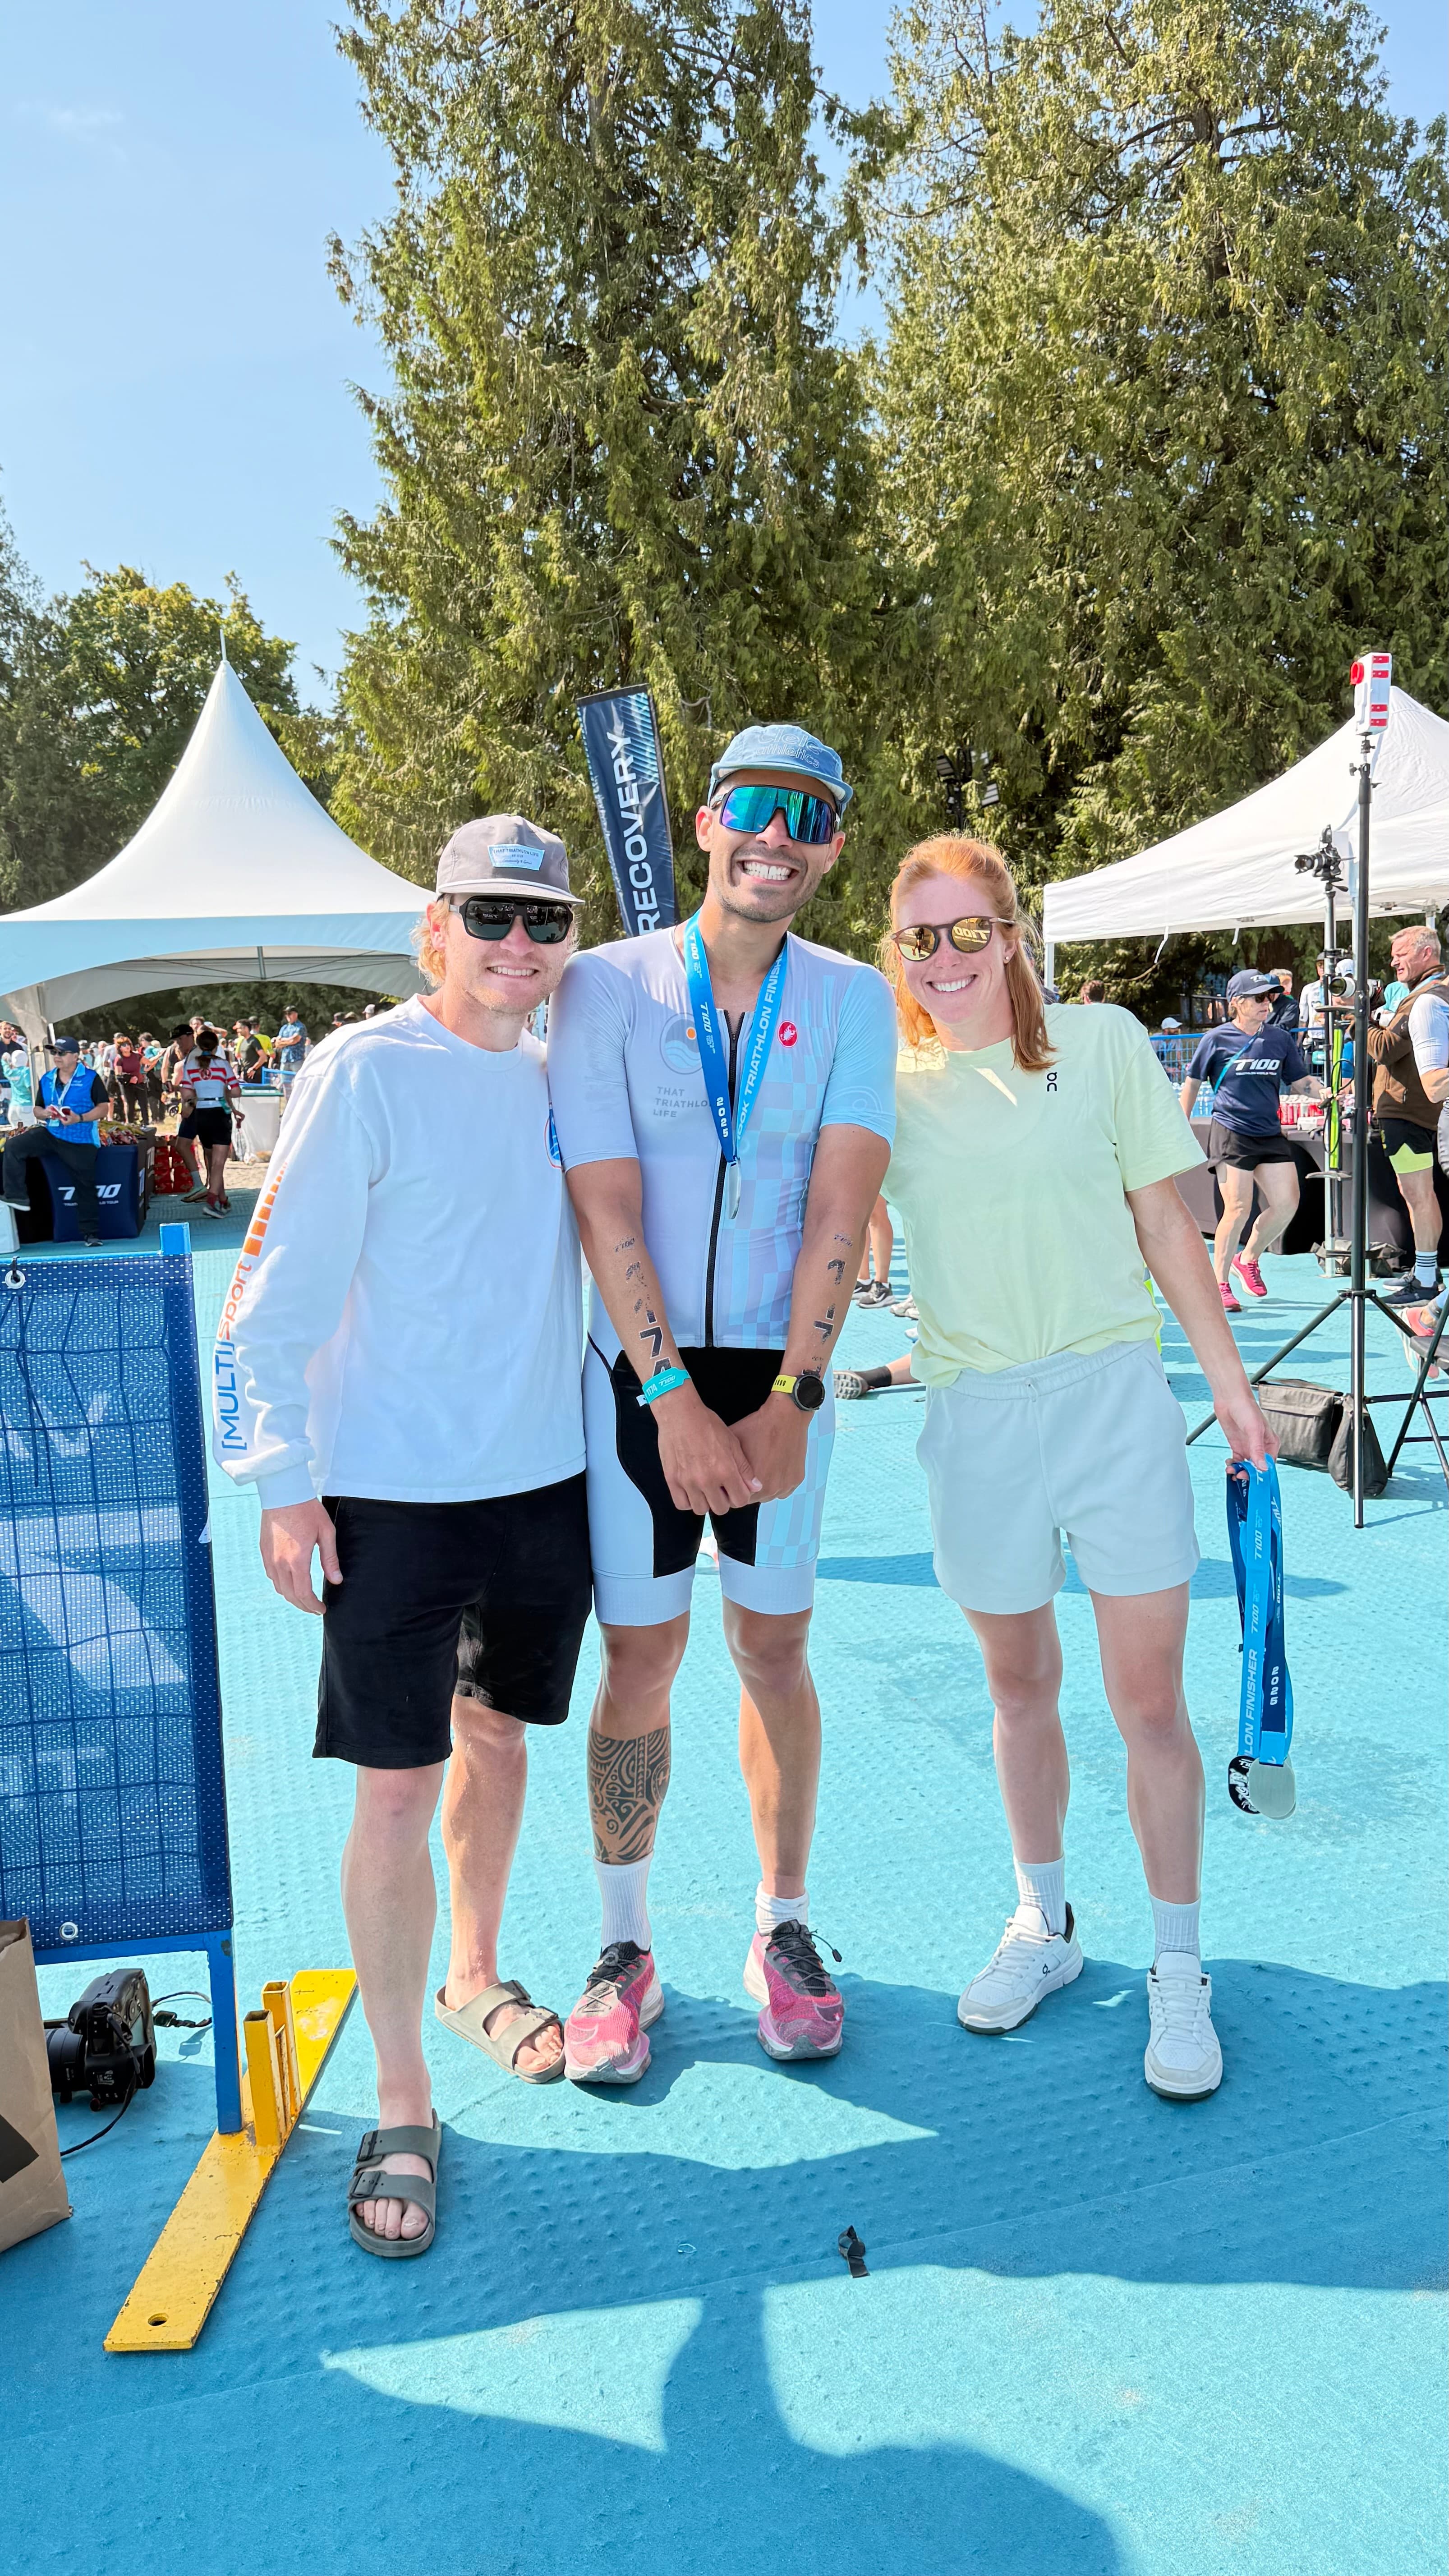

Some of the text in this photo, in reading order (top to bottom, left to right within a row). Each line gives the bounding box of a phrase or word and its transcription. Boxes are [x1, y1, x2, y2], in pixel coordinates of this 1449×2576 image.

[607, 732, 662, 935] RECOVERY
[689, 932, 699, 960] T100
[700, 1002, 712, 1033] T100
[745, 1006, 772, 1095] TRIATHLON
[1233, 1059, 1280, 1071] T100
[655, 1098, 710, 1108] TRIATHLO
[657, 1086, 685, 1097] THAT
[653, 1109, 677, 1118] LIFE
[716, 1097, 728, 1137] 2025
[658, 1375, 676, 1386] T100
[1255, 1529, 1263, 1560] T100
[1251, 1604, 1259, 1634] T100
[1245, 1648, 1257, 1720] FINISHER
[1270, 1666, 1279, 1705] 2025
